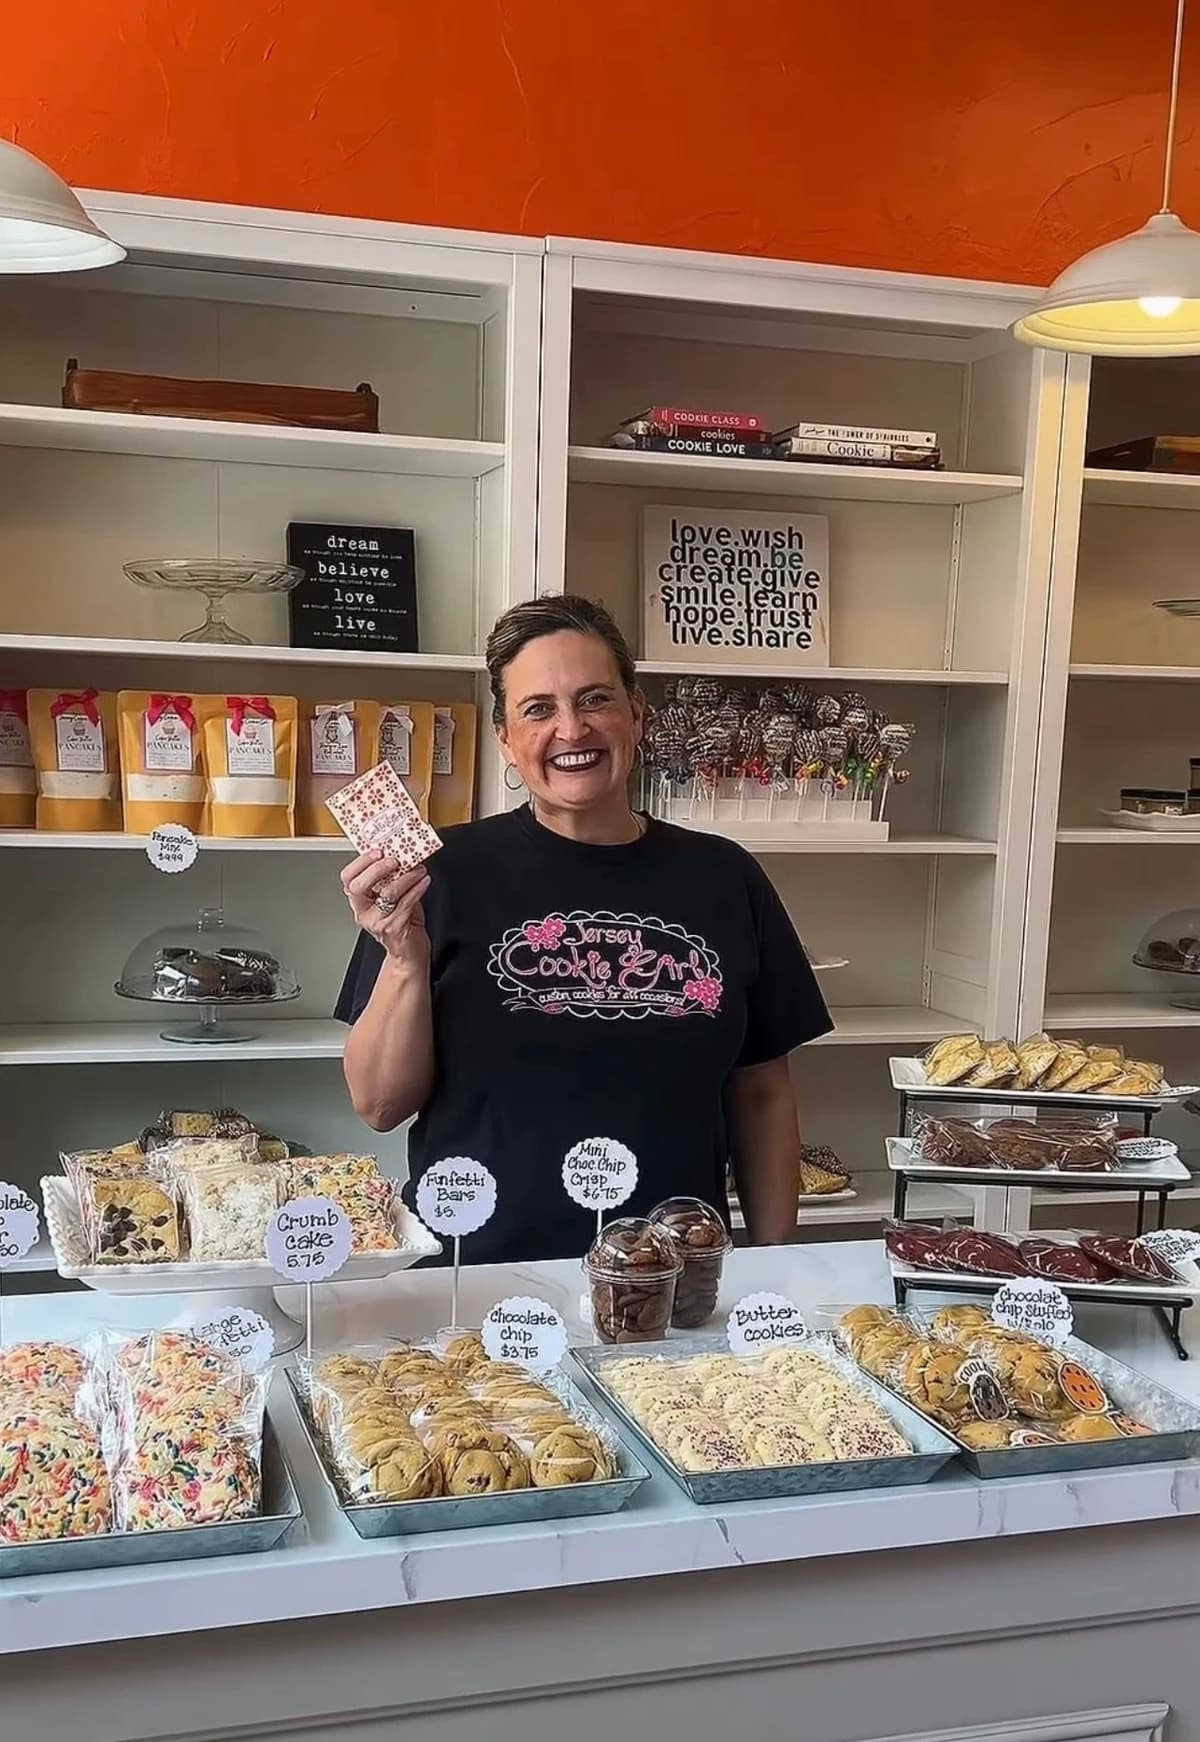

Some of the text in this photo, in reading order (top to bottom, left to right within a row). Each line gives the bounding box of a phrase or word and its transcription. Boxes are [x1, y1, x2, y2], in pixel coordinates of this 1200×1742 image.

[674, 412, 740, 426] COOKIE CLASS
[701, 428, 735, 441] cookies
[668, 440, 746, 455] COOKIE LOVE
[327, 536, 379, 550] dream
[318, 561, 389, 578] believe
[334, 588, 375, 604] love
[335, 615, 376, 631] live
[563, 922, 642, 951] Jersey
[506, 941, 704, 990] Cookie Girl
[607, 985, 620, 999] for
[578, 1143, 609, 1157] Mini
[598, 1157, 626, 1175] Chip
[426, 1170, 486, 1187] Funfetti
[571, 1172, 608, 1188] Crisp
[437, 1187, 476, 1202] Bars
[277, 1208, 339, 1232] Crumb
[287, 1251, 325, 1268] 5.75
[736, 1305, 798, 1326] Butter
[500, 1343, 538, 1359] $3.75
